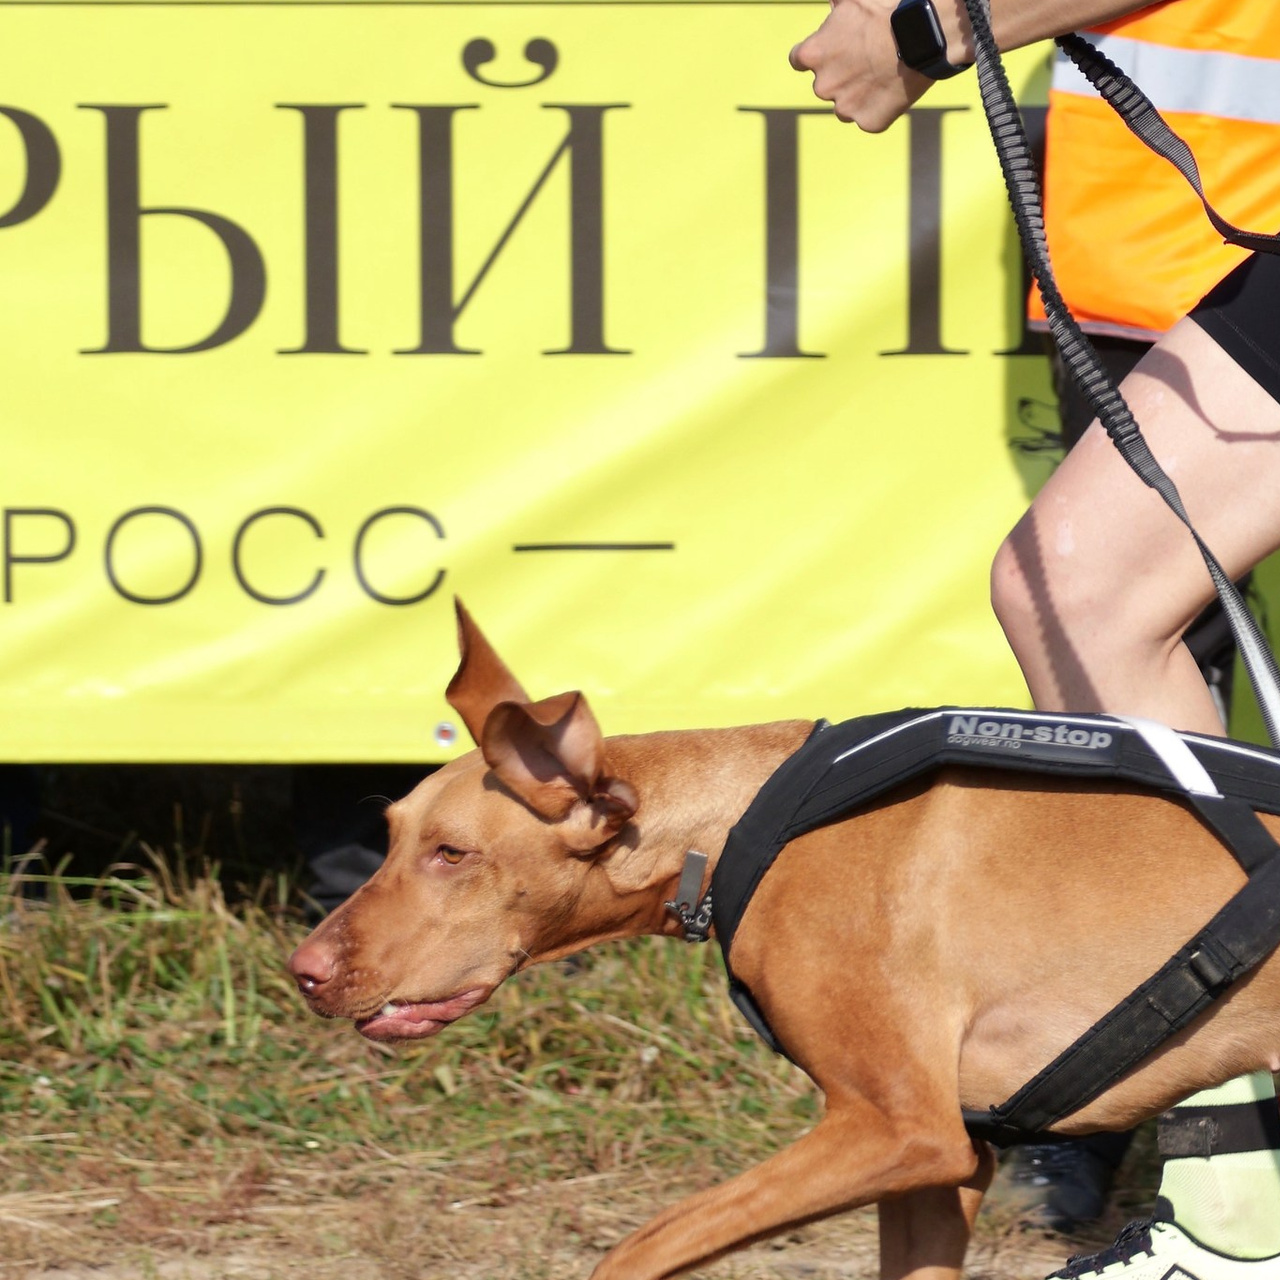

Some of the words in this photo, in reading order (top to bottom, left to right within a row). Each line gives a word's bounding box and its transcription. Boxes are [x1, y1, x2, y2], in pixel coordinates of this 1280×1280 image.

[2, 505, 447, 607] РОСС
[947, 734, 1021, 749] dogwear.no
[948, 716, 1113, 749] Non-stop
